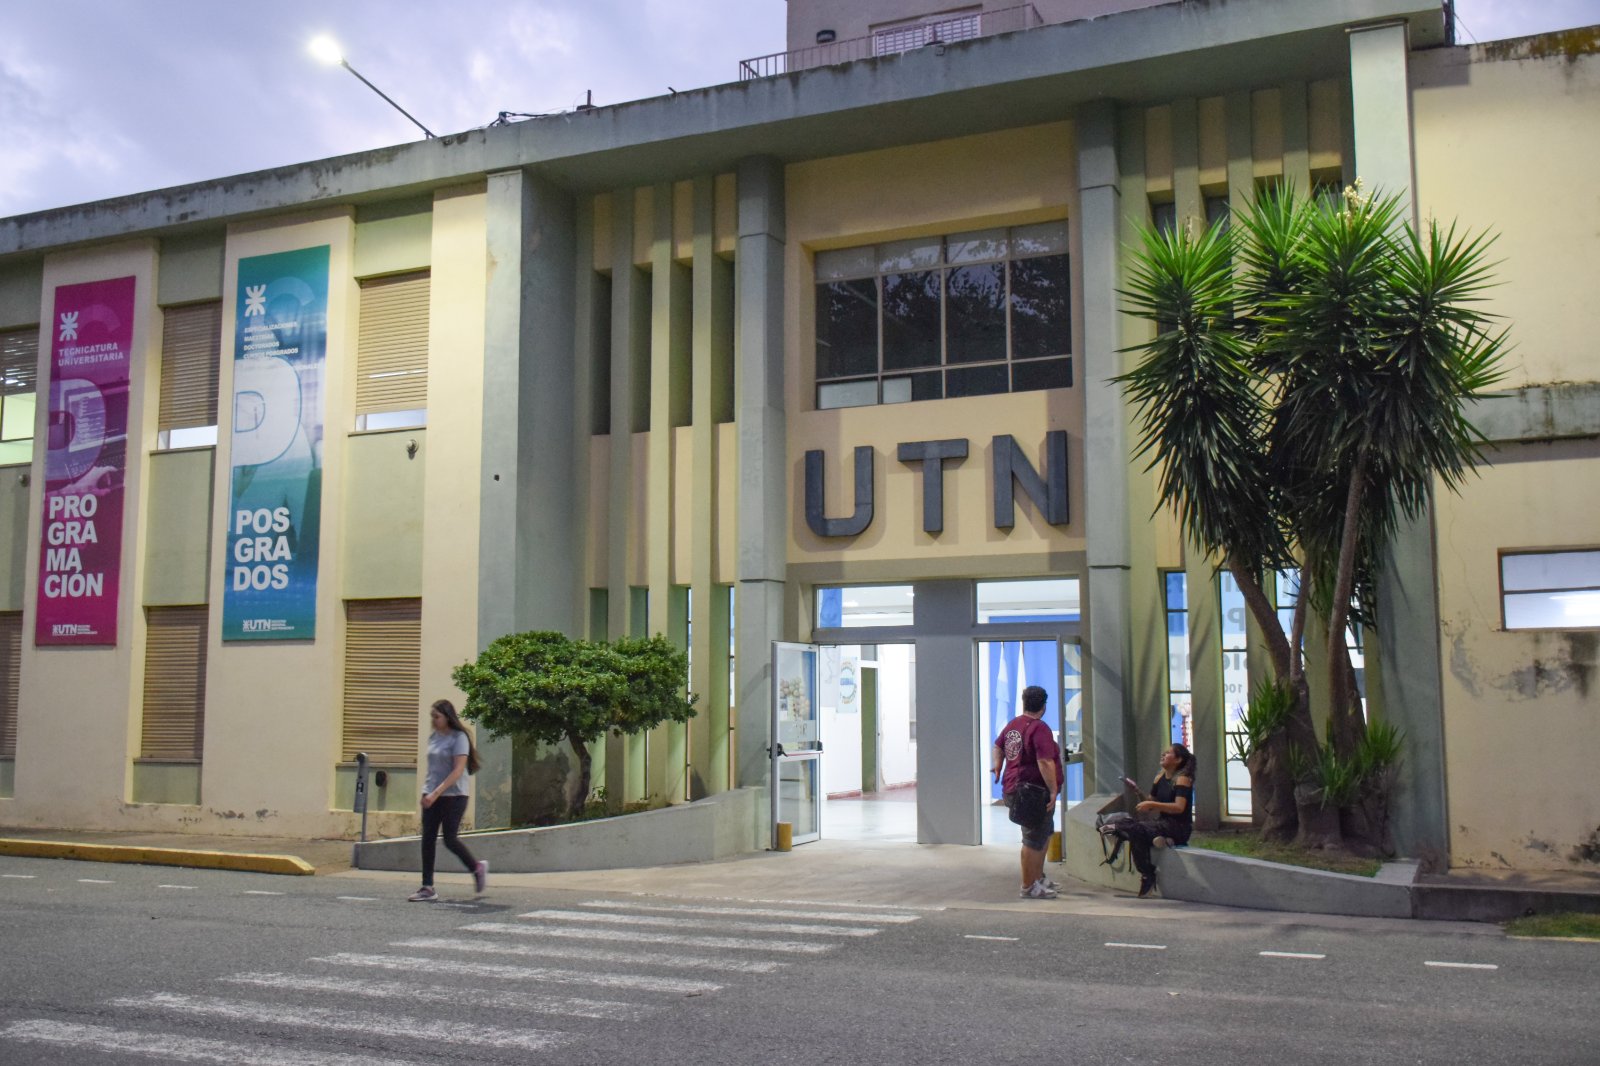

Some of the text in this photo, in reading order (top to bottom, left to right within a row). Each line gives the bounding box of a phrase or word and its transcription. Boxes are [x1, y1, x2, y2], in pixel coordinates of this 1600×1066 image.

[58, 342, 118, 357] TECNICATURA
[58, 352, 124, 366] UNIVERSITARIA
[243, 341, 280, 351] DOCTORADOS
[804, 429, 1070, 538] UTN
[49, 493, 98, 521] PRO
[235, 506, 290, 535] POS
[48, 520, 98, 546] GRA
[46, 546, 82, 573] MA
[234, 535, 292, 564] GRA
[44, 563, 103, 598] CIÓN
[233, 563, 289, 592] DOS
[58, 623, 77, 634] UTN
[250, 618, 271, 630] UTN
